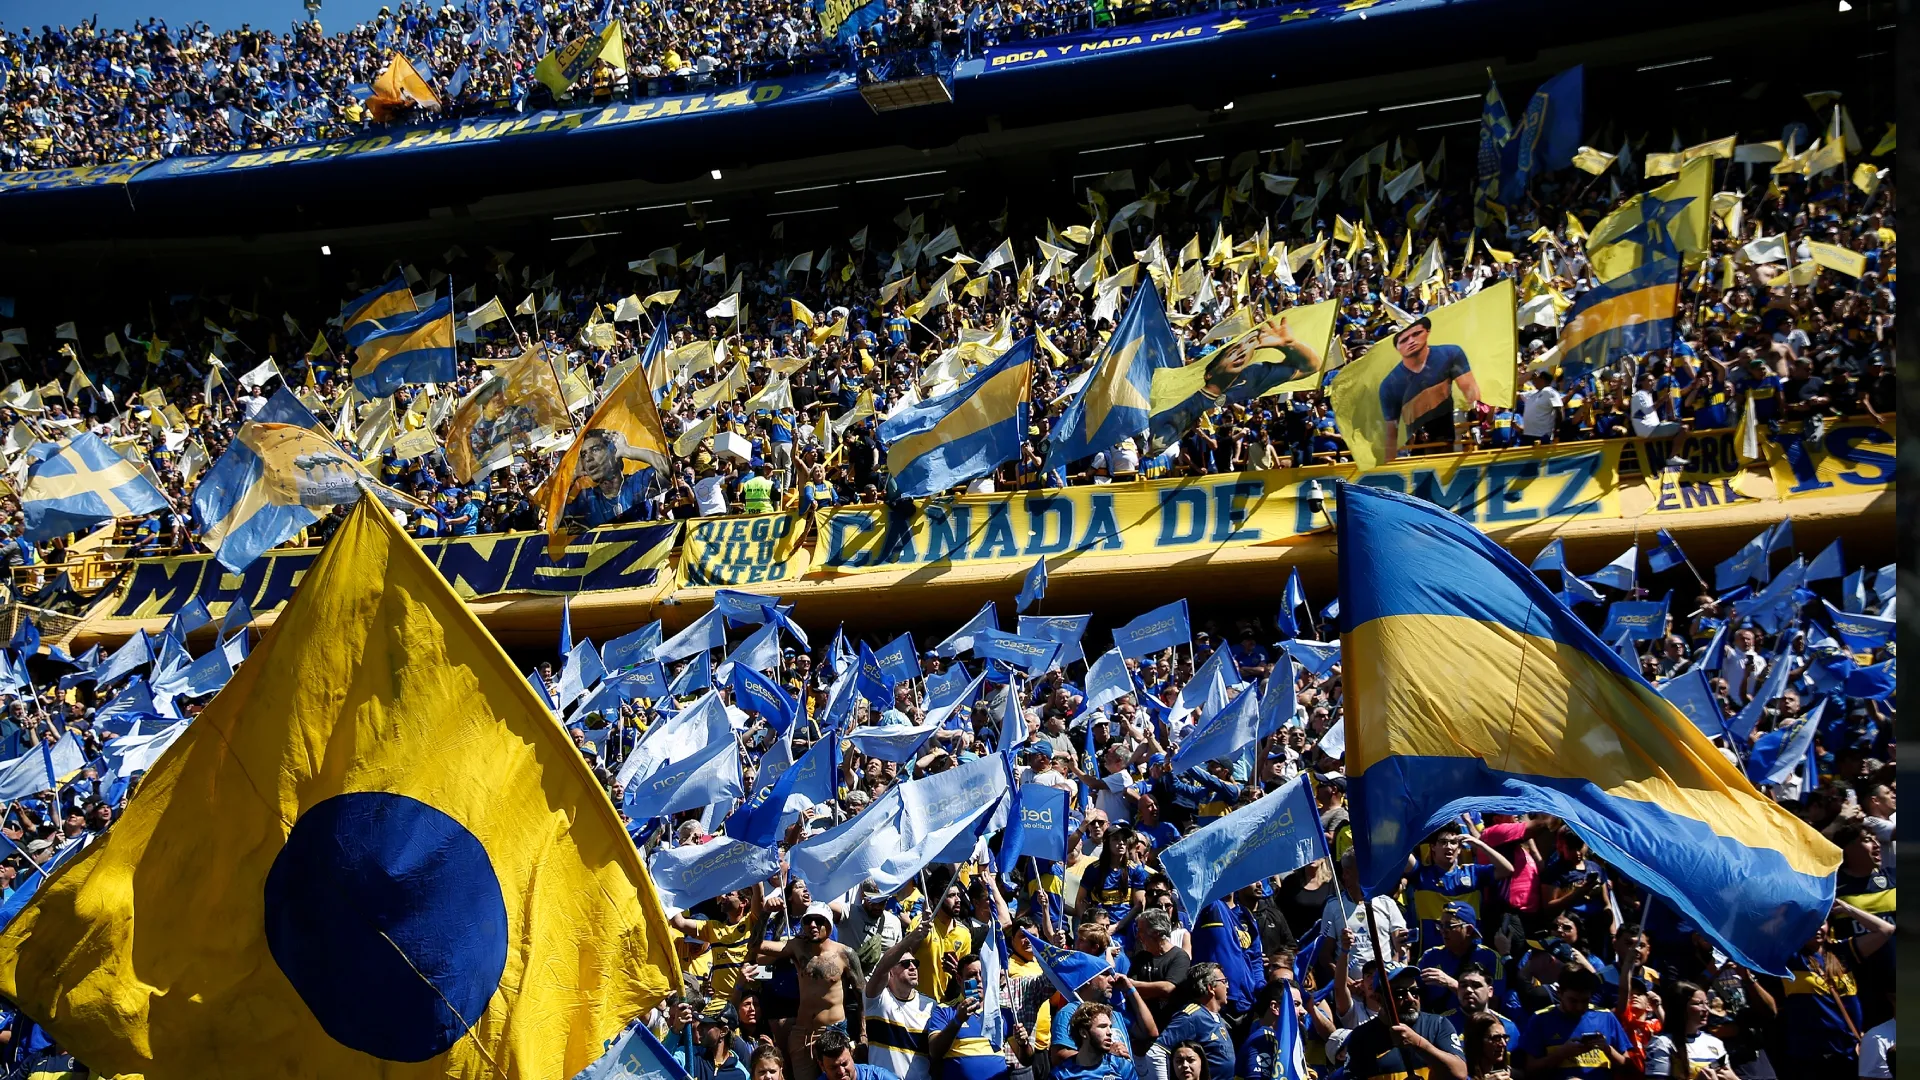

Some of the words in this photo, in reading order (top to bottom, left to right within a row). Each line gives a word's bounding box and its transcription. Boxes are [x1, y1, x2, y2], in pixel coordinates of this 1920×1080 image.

[992, 49, 1048, 67] BOCA
[1058, 45, 1074, 55] Y
[1079, 35, 1143, 53] NADA
[1150, 25, 1203, 42] MÁS
[227, 135, 394, 168] BARRIO
[394, 112, 586, 150] FAMILIA
[1155, 480, 1264, 546] DE
[1294, 450, 1604, 534] GMEZ
[694, 515, 793, 543] DIEGO
[112, 524, 680, 616] MARNEZ
